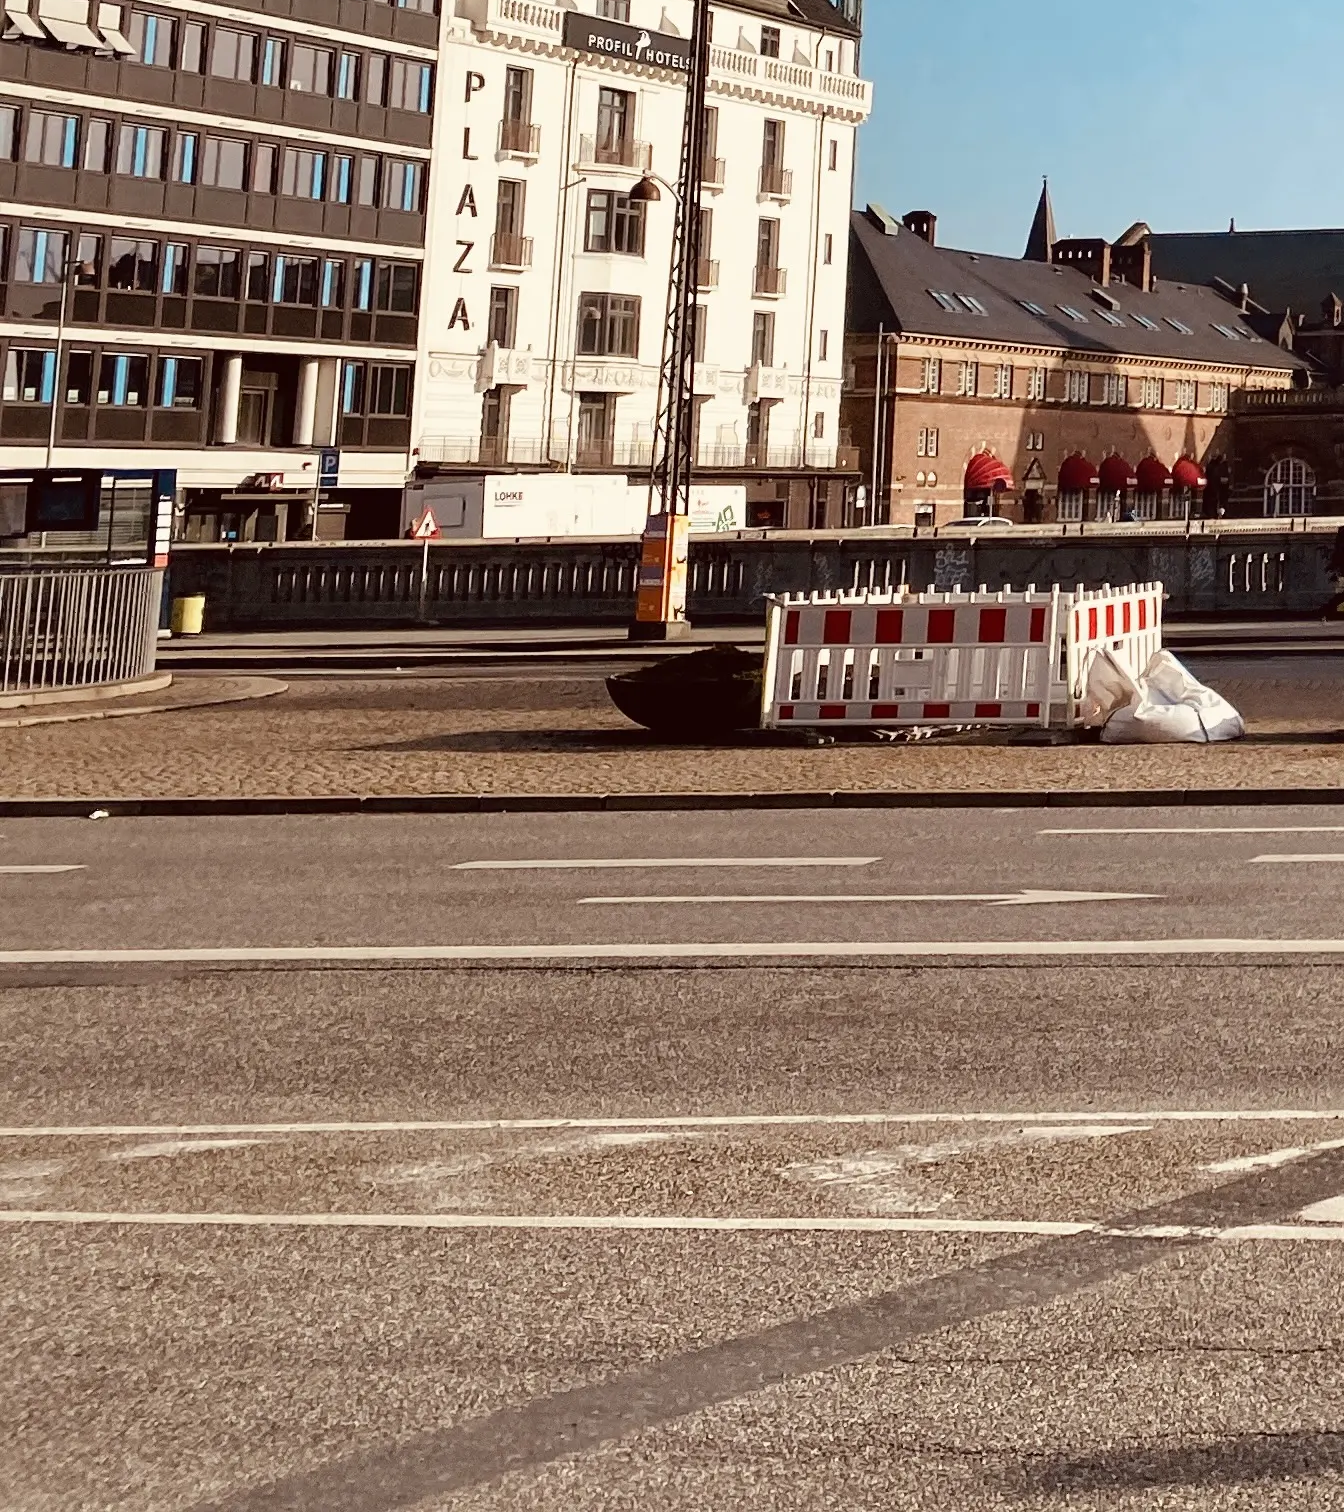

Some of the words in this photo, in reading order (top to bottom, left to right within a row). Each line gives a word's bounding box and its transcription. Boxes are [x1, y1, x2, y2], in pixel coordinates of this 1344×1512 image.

[588, 34, 633, 57] PROFIL
[447, 70, 486, 331] PLAZA
[324, 455, 337, 473] P
